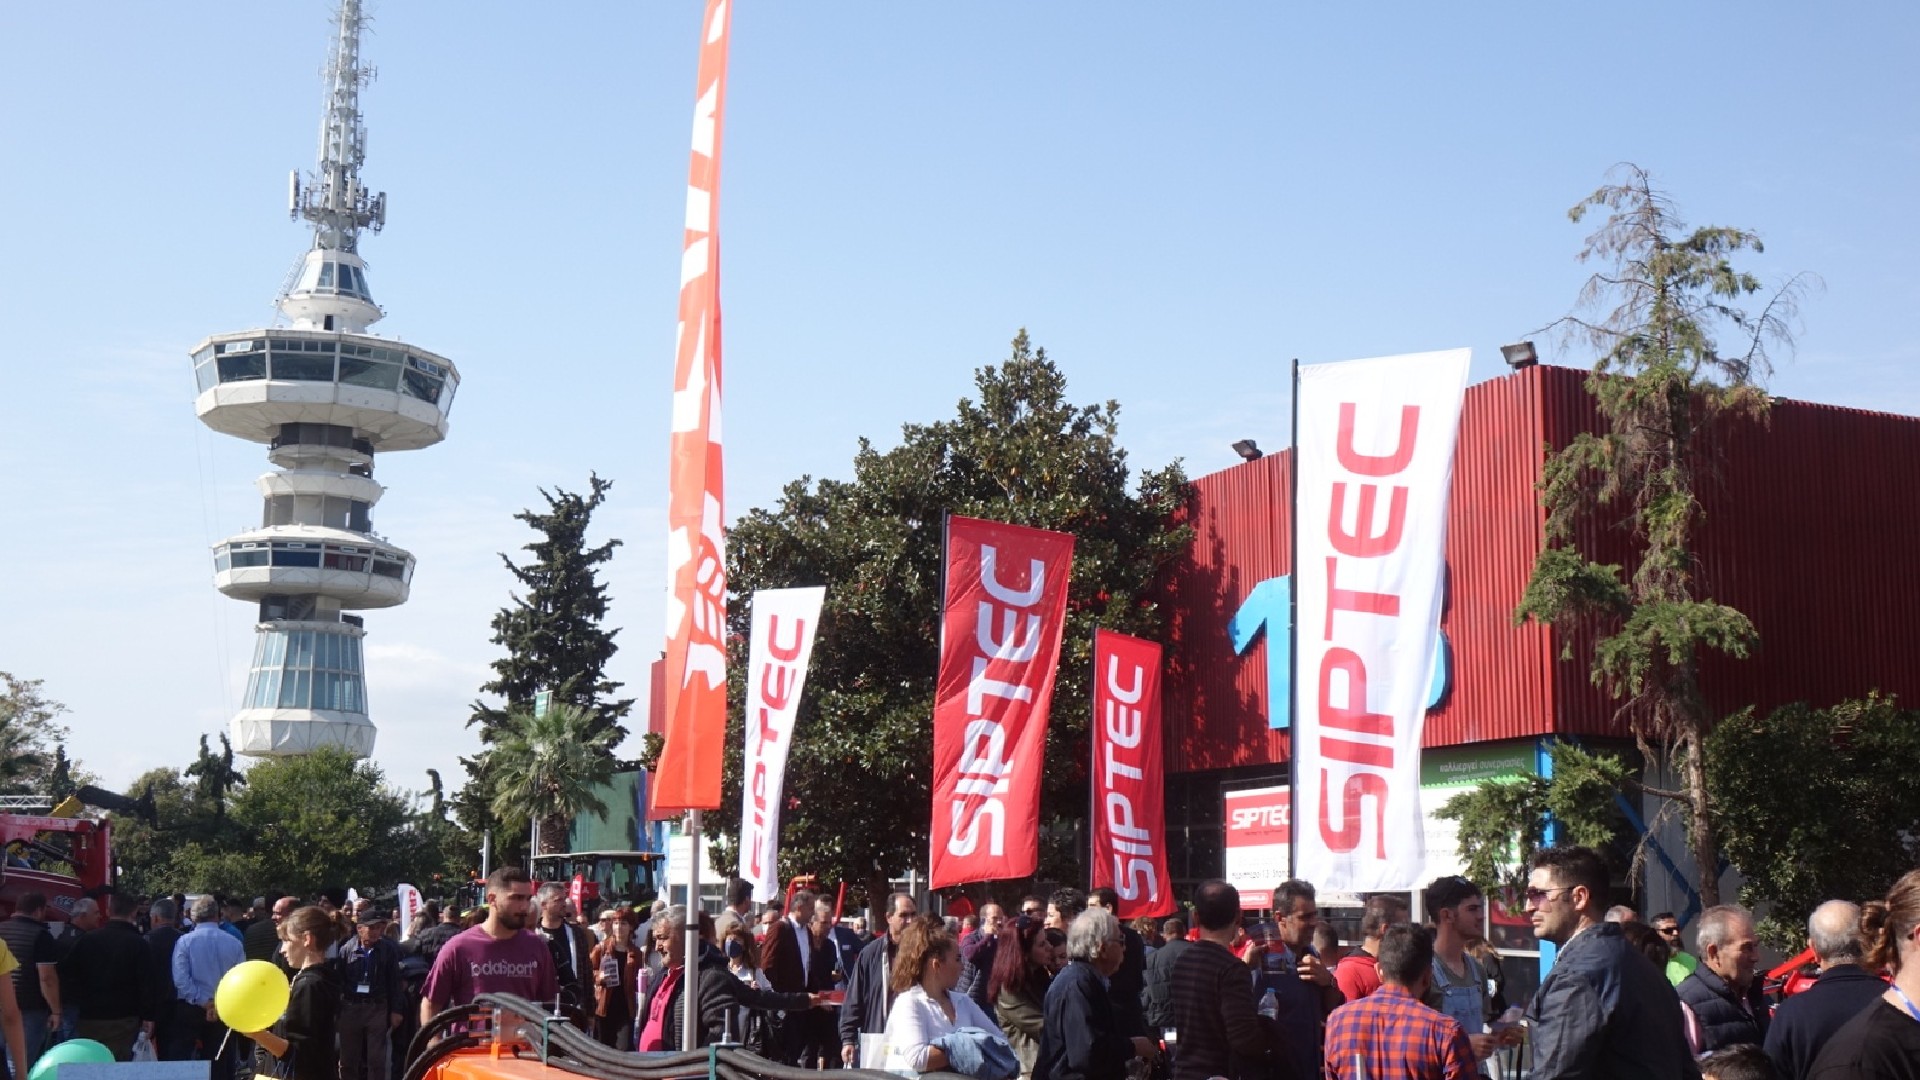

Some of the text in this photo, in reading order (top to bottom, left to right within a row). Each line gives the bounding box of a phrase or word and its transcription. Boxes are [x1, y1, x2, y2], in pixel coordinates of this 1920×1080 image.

[947, 543, 1045, 857] SIPTEC
[1105, 653, 1158, 903] SIPTEC
[1317, 402, 1420, 860] SIPTEC
